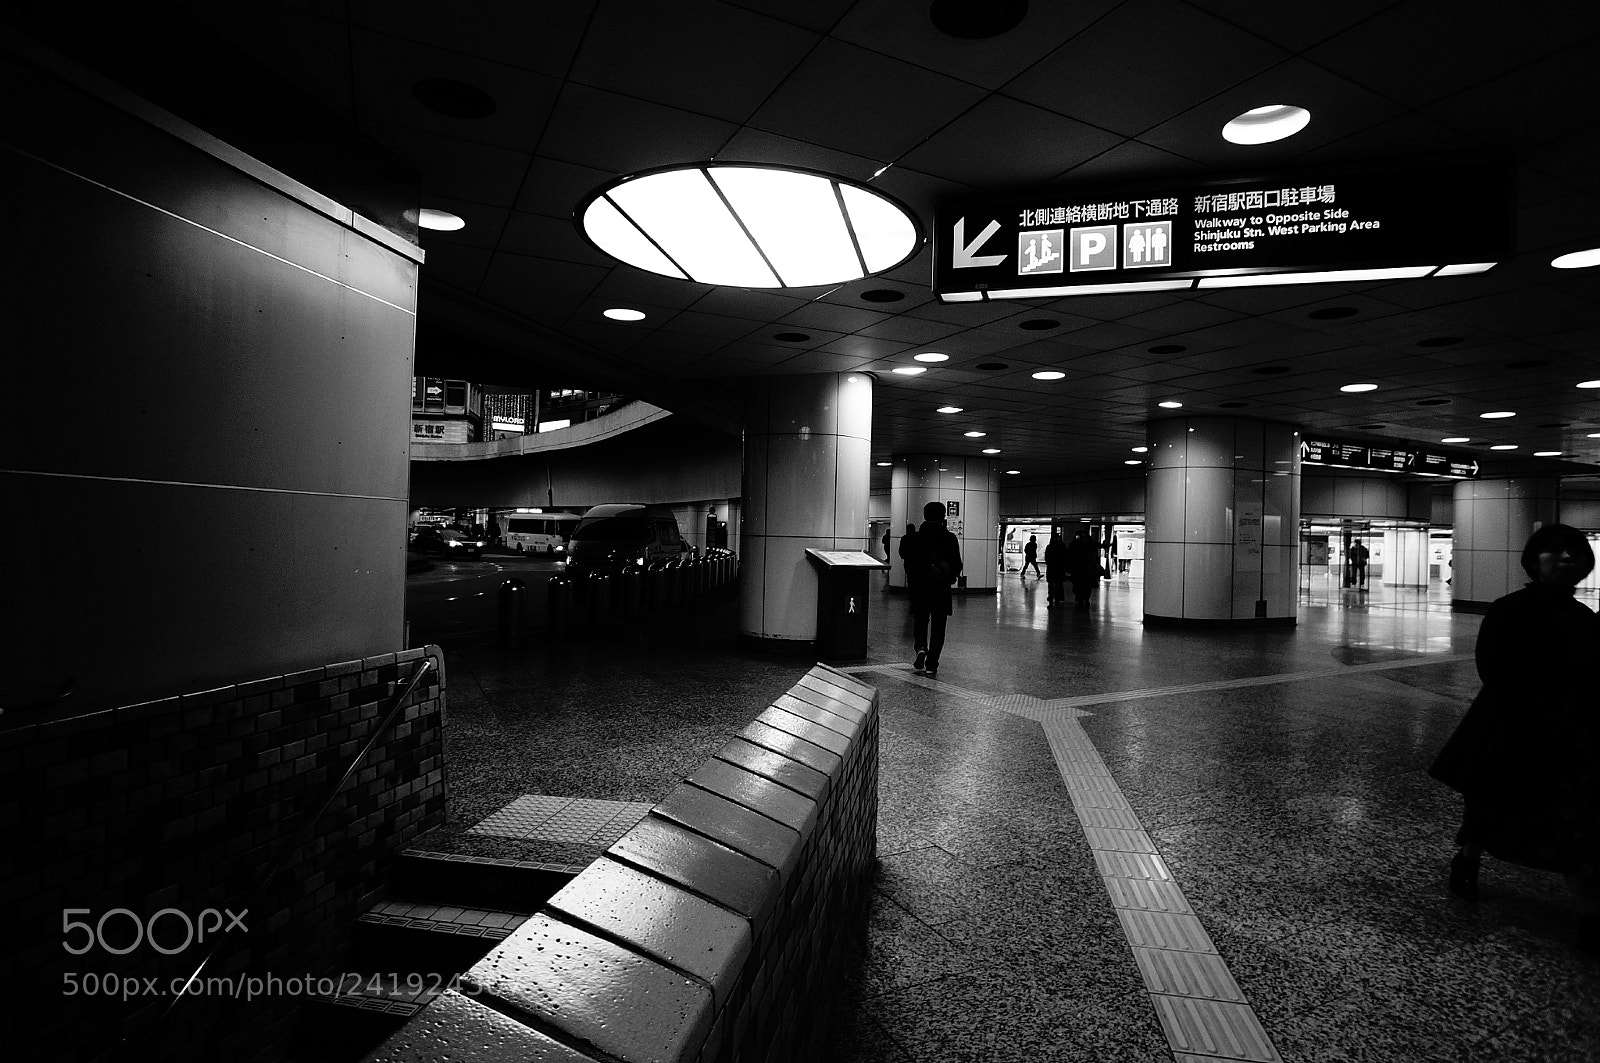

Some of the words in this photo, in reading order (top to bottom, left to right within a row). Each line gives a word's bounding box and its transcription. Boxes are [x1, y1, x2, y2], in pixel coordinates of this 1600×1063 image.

[1194, 185, 1336, 213] 新宿駅西口駐車場
[1018, 198, 1179, 227] 北側連絡横断地下通路
[1194, 217, 1247, 229] Walkway
[1250, 216, 1263, 225] to
[1266, 210, 1321, 225] Opposite
[1323, 208, 1350, 220] Side
[1194, 228, 1241, 242] Shinjuku
[1243, 227, 1265, 238] Stn.
[1268, 225, 1299, 236] West
[1301, 221, 1347, 234] Parking
[1349, 219, 1381, 231] Area
[1080, 232, 1107, 265] P
[1193, 241, 1255, 252] Restrooms
